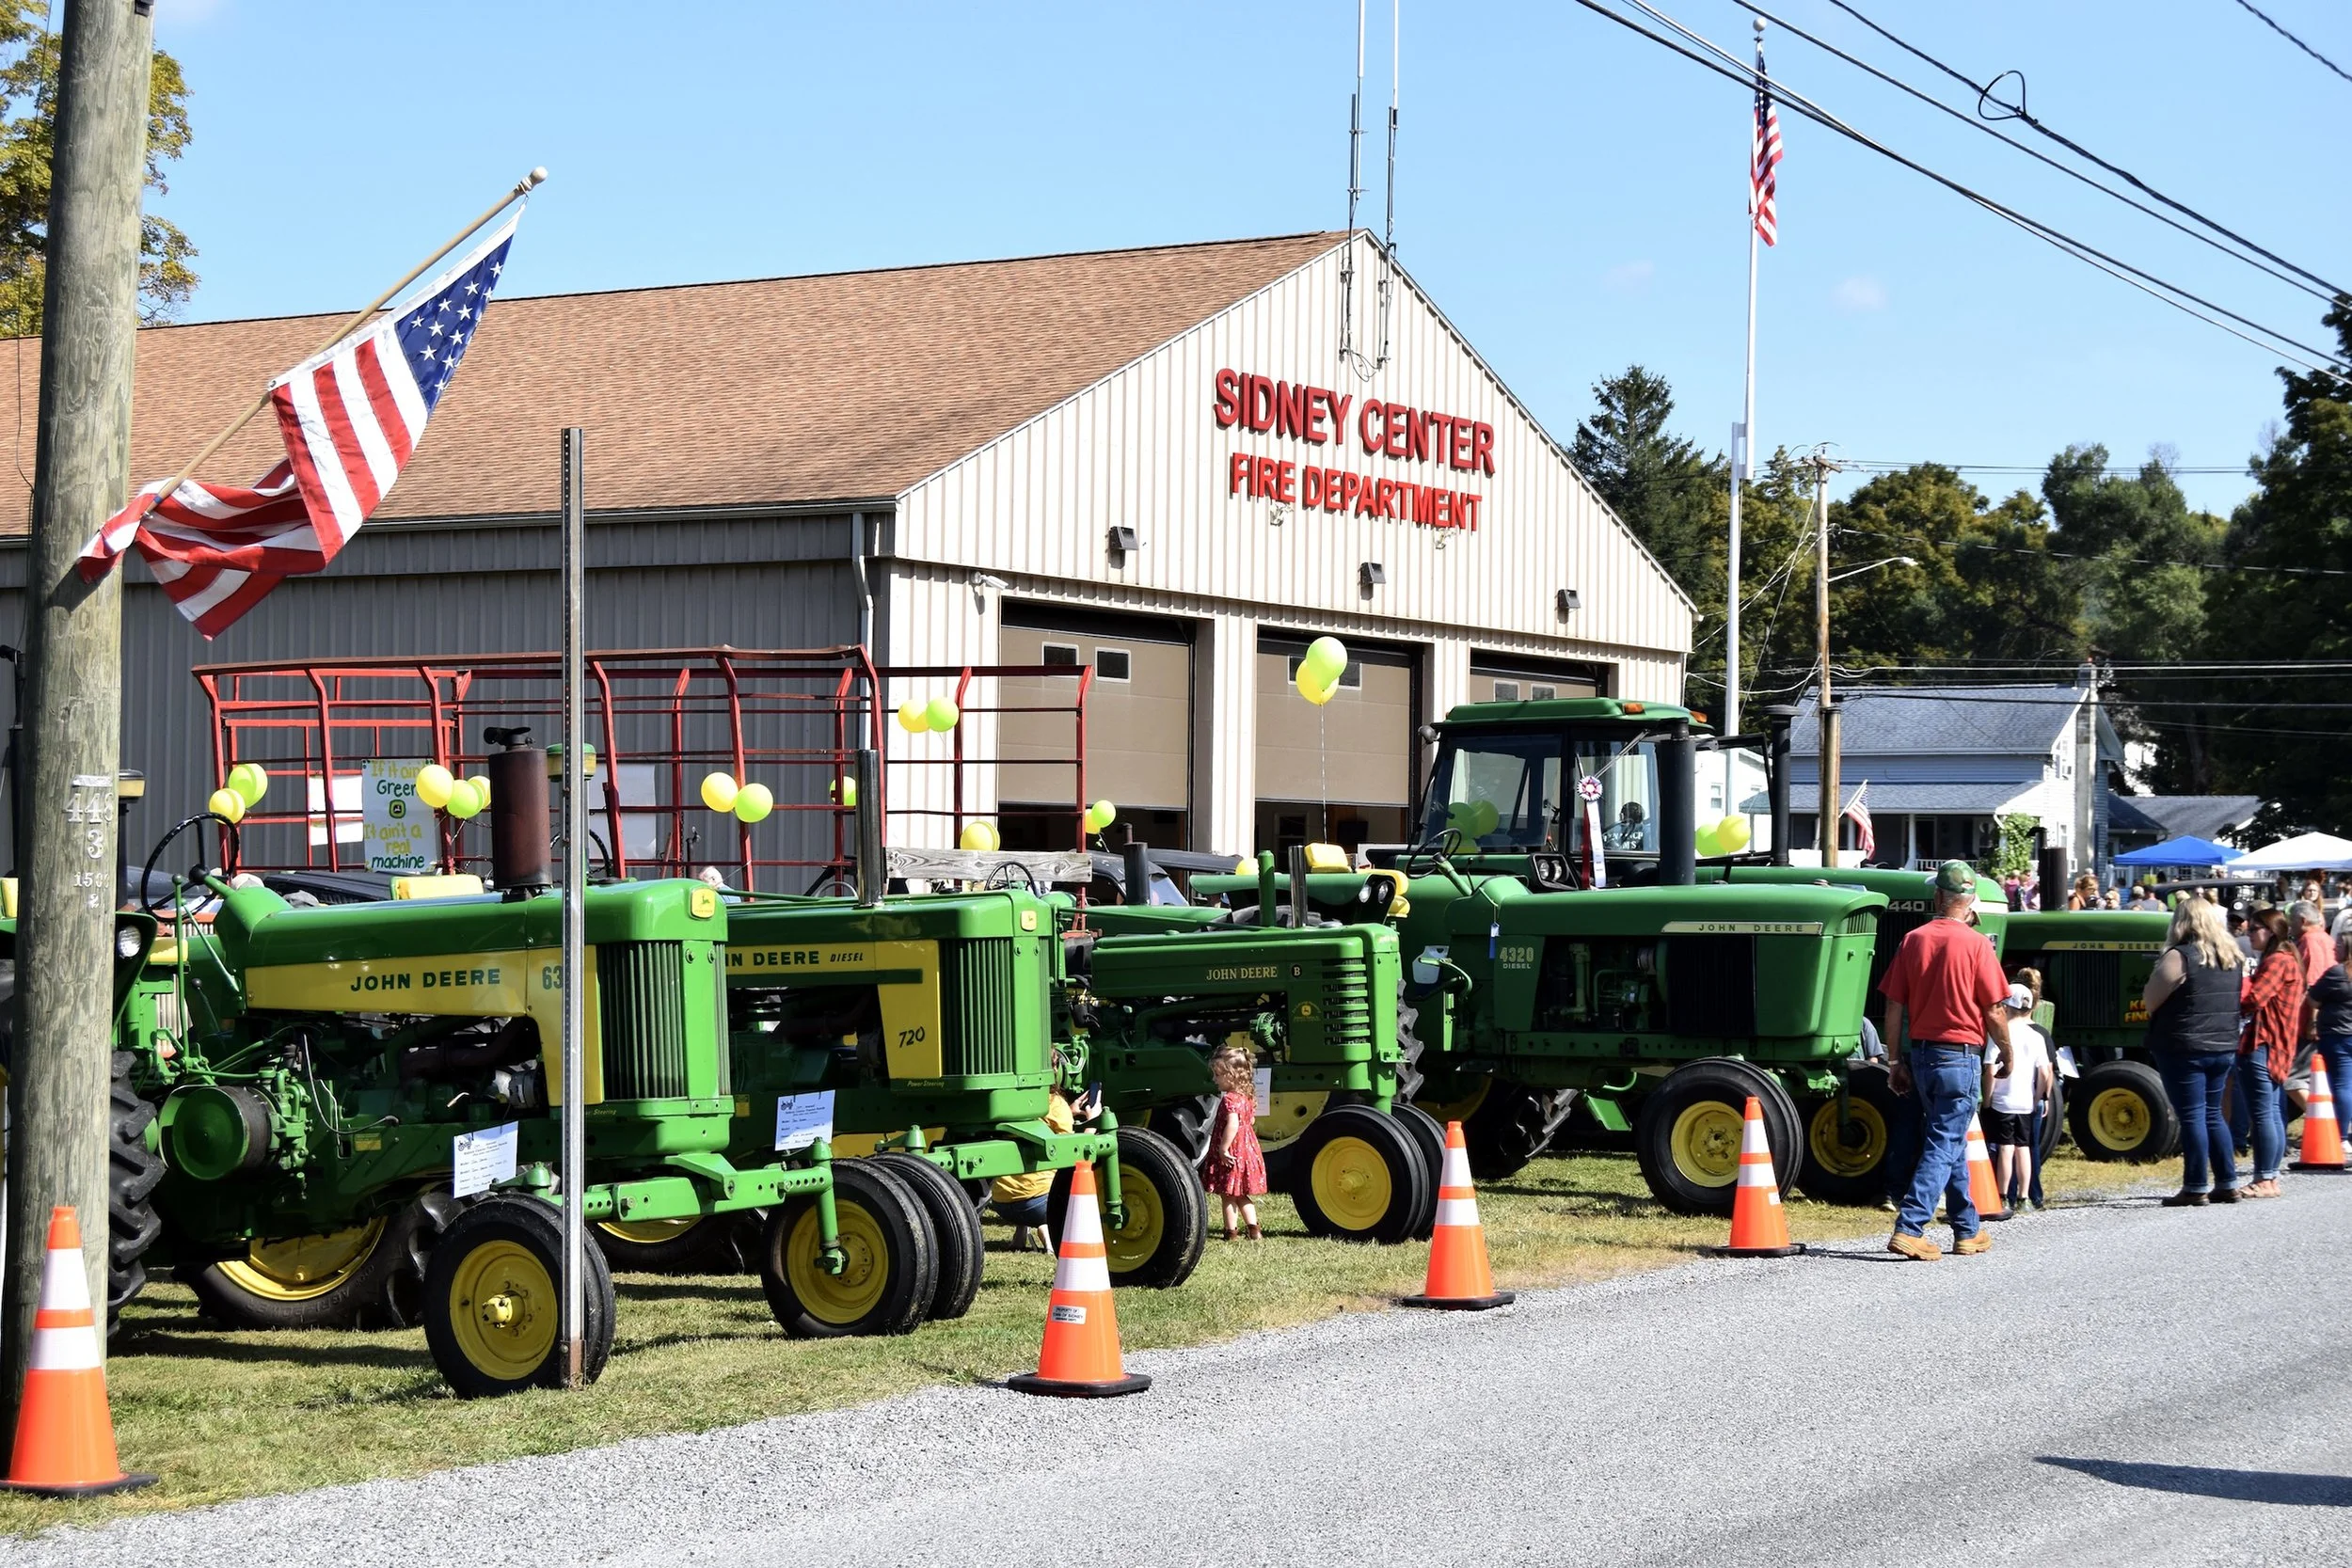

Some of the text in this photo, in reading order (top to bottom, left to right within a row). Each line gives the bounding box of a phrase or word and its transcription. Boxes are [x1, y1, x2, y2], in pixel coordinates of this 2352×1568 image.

[1214, 368, 1496, 477] SIDNEY CENTER
[1230, 452, 1483, 533] FIRE DEPARTMENT
[372, 760, 385, 777] If
[379, 822, 406, 841] ain't
[410, 824, 422, 839] a
[87, 829, 104, 860] 3
[386, 839, 412, 855] real
[372, 853, 425, 869] machine
[1888, 900, 1926, 912] 440
[1698, 924, 1804, 932] JOHN DEERE
[754, 951, 819, 966] DEERE
[830, 952, 865, 963] DIESEL
[1500, 946, 1534, 962] 4320
[542, 965, 564, 990] 63
[1206, 966, 1279, 981] JOHN DEERE
[1294, 966, 1301, 976] B
[350, 968, 501, 992] JOHN DEERE
[898, 1025, 926, 1049] 720
